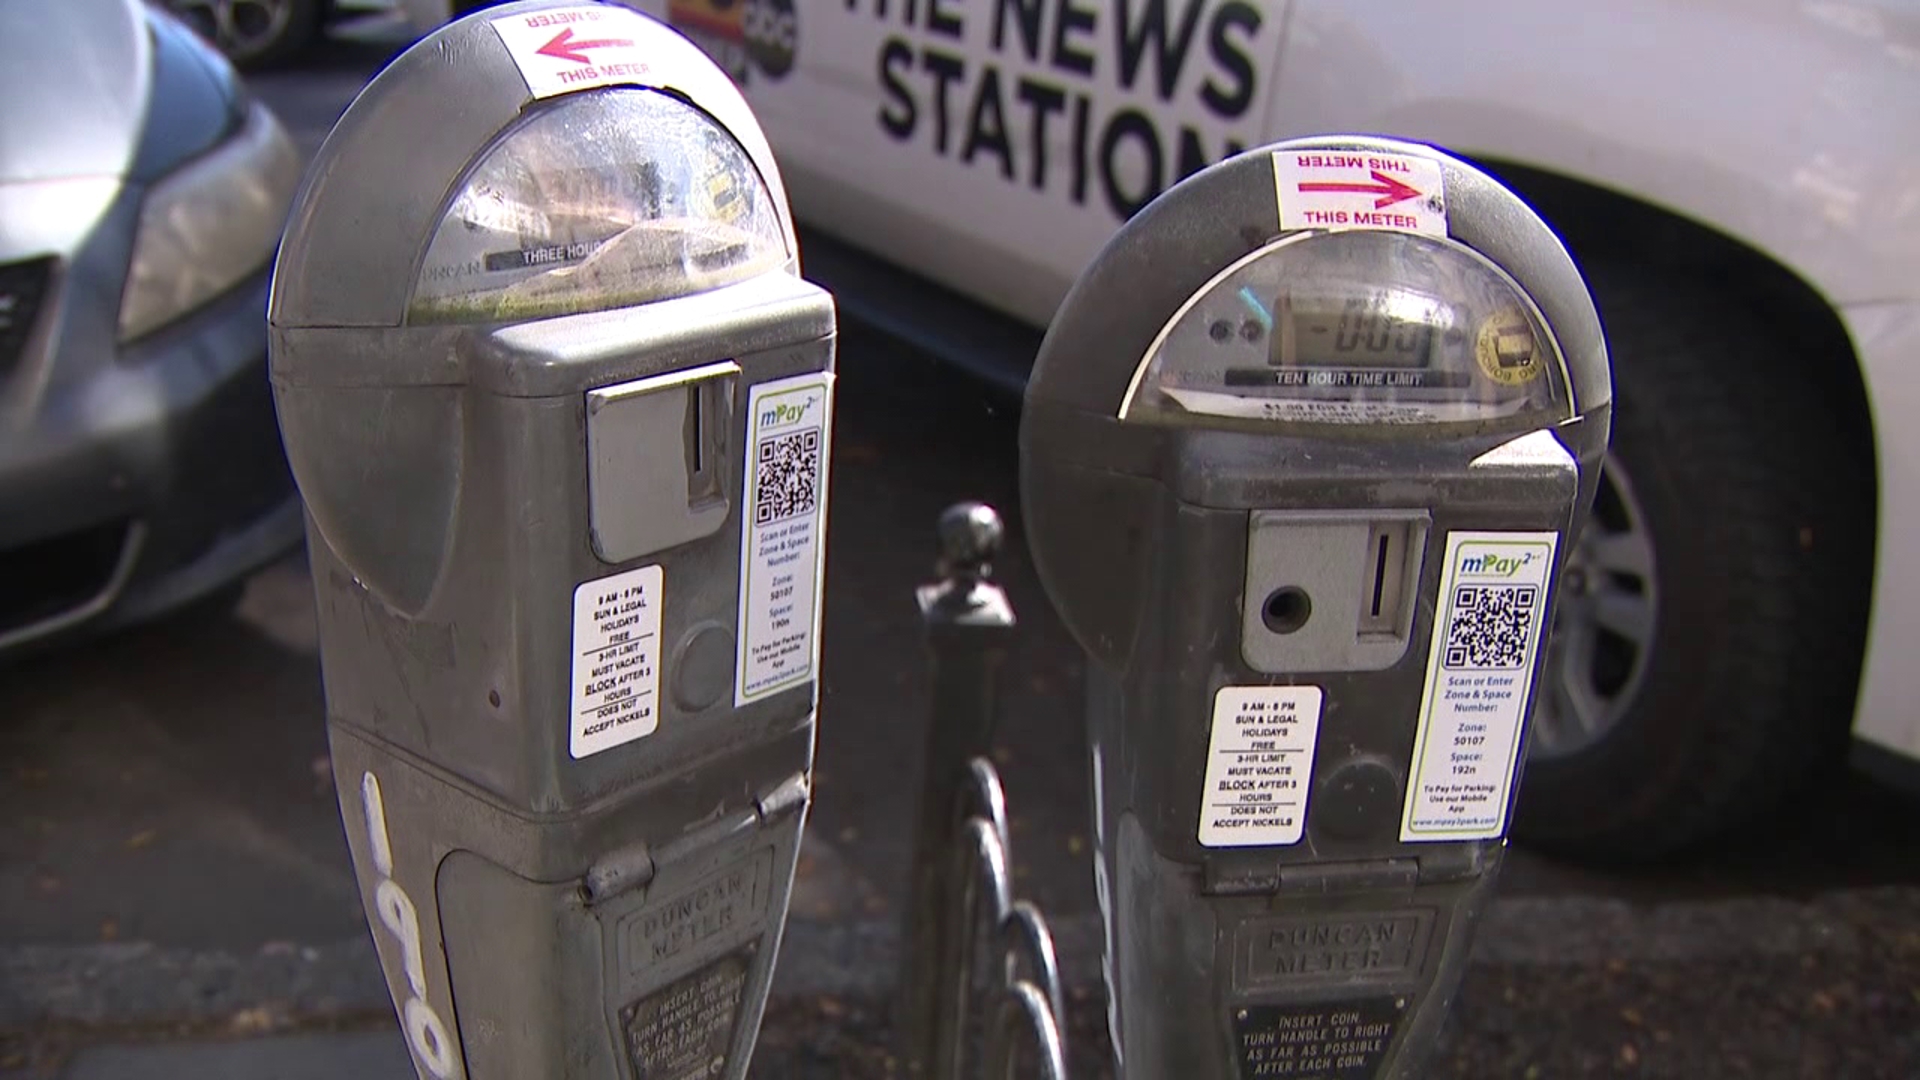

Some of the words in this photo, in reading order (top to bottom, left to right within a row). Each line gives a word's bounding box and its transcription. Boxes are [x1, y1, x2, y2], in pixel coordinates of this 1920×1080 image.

[525, 11, 584, 27] METER
[990, 0, 1263, 119] NEWS
[556, 67, 598, 83] THIS
[599, 63, 652, 77] METER
[1297, 156, 1363, 168] METER
[1368, 158, 1411, 173] THIS
[1303, 211, 1348, 223] THIS
[1353, 211, 1418, 228] METER
[523, 247, 563, 264] THREE
[1275, 372, 1304, 385] TEN
[1306, 372, 1347, 385] HOUR
[1350, 372, 1384, 385] TIME
[1386, 372, 1423, 386] LIMIT
[605, 592, 617, 604] AM
[631, 585, 643, 596] PM
[594, 608, 611, 621] SUN
[620, 599, 647, 613] LEGAL
[600, 615, 639, 633] HOLIDAYS
[609, 631, 629, 643] FREE
[619, 642, 639, 656] LIMIT
[592, 663, 614, 678] MUST
[615, 654, 645, 670] VACATE
[585, 677, 616, 697] BLOCK
[618, 668, 644, 685] AFTER
[1449, 677, 1473, 687] Scan
[1487, 676, 1513, 686] Enter
[604, 687, 631, 703] HOURS
[1445, 690, 1471, 700] Zone
[1482, 690, 1512, 701] Space
[597, 704, 619, 719] DOES
[621, 698, 637, 711] NOT
[1250, 702, 1265, 711] AM
[1281, 702, 1296, 711] PM
[1454, 703, 1498, 713] Number:
[583, 719, 615, 737] ACCEPT
[616, 707, 650, 726] NICKELS
[1235, 715, 1255, 724] SUN
[1267, 715, 1299, 724] LEGAL
[1242, 728, 1289, 737] HOLIDAYS
[1458, 723, 1487, 733] Zone:
[1251, 741, 1275, 750] FREE
[1454, 736, 1485, 746] 50107
[1261, 754, 1286, 763] LIMIT
[1451, 752, 1483, 763] Space:
[1228, 766, 1253, 776] MUST
[1256, 766, 1292, 776] VACATE
[1452, 765, 1476, 775] 192n
[1218, 780, 1255, 791] BLOCK
[1257, 780, 1289, 790] AFTER
[1435, 785, 1450, 794] Pay
[1239, 793, 1273, 803] HOURS
[1429, 795, 1444, 803] Use
[1460, 793, 1487, 802] Mobile
[1230, 806, 1256, 815] DOES
[1259, 806, 1278, 814] NOT
[1448, 804, 1465, 813] App
[1212, 818, 1250, 828] ACCEPT
[1252, 818, 1293, 828] NICKELS
[644, 873, 742, 938] DUNCAN
[362, 771, 458, 1080] 190
[652, 905, 731, 960] METER
[1269, 922, 1395, 950] DUNCAN
[1277, 951, 1380, 974] METER
[1279, 1014, 1323, 1029] INSERT
[1243, 1033, 1274, 1046] TURN
[1280, 1028, 1327, 1044] HANDLE
[1335, 1027, 1349, 1039] TO
[1354, 1023, 1390, 1037] RIGHT
[1248, 1049, 1263, 1061] AS
[1270, 1046, 1294, 1059] FAR
[1302, 1044, 1317, 1057] AS
[1324, 1040, 1382, 1055] POSSIBLE
[1255, 1061, 1293, 1074] AFTER
[1300, 1058, 1332, 1071] EACH
